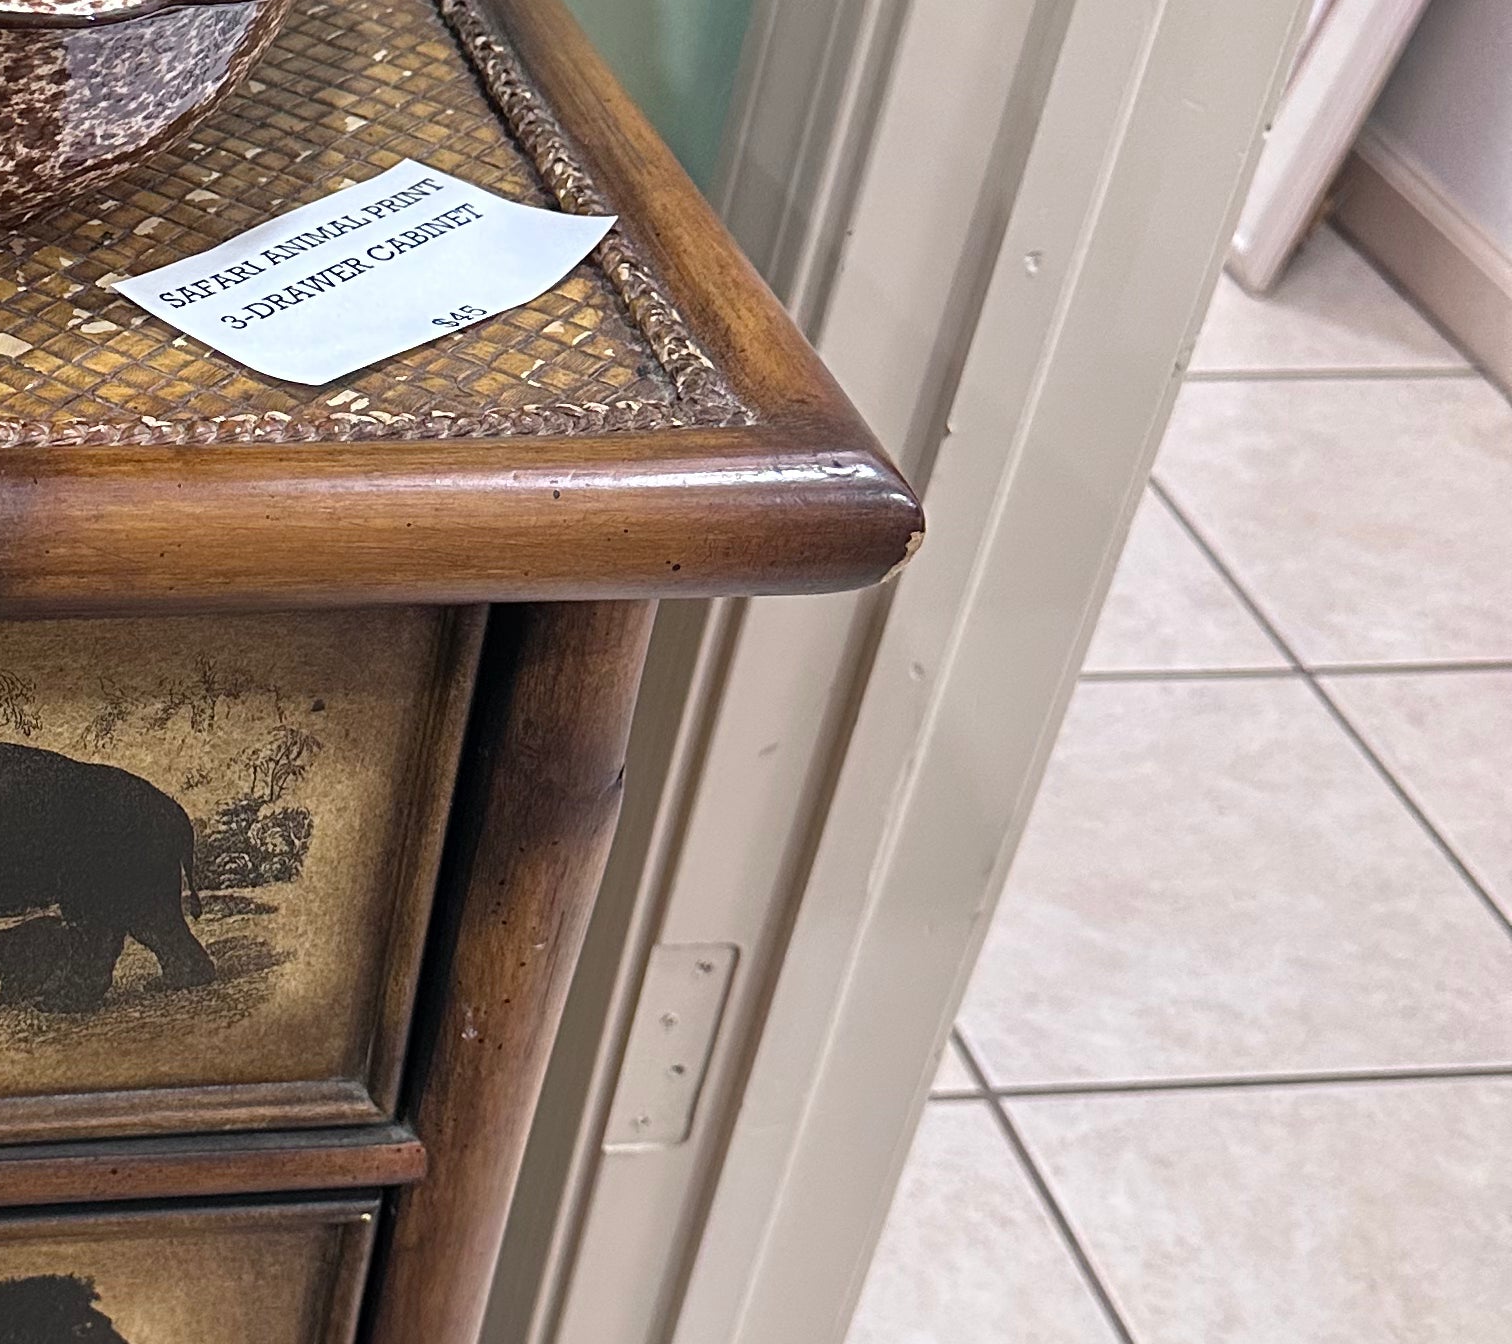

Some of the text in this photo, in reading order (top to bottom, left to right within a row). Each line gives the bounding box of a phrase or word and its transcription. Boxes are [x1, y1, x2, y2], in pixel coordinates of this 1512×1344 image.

[159, 177, 445, 309] SAFARI ANIMAL PRINT
[220, 202, 484, 330] 3-DRAWER CABINET
[431, 304, 488, 328] $45
